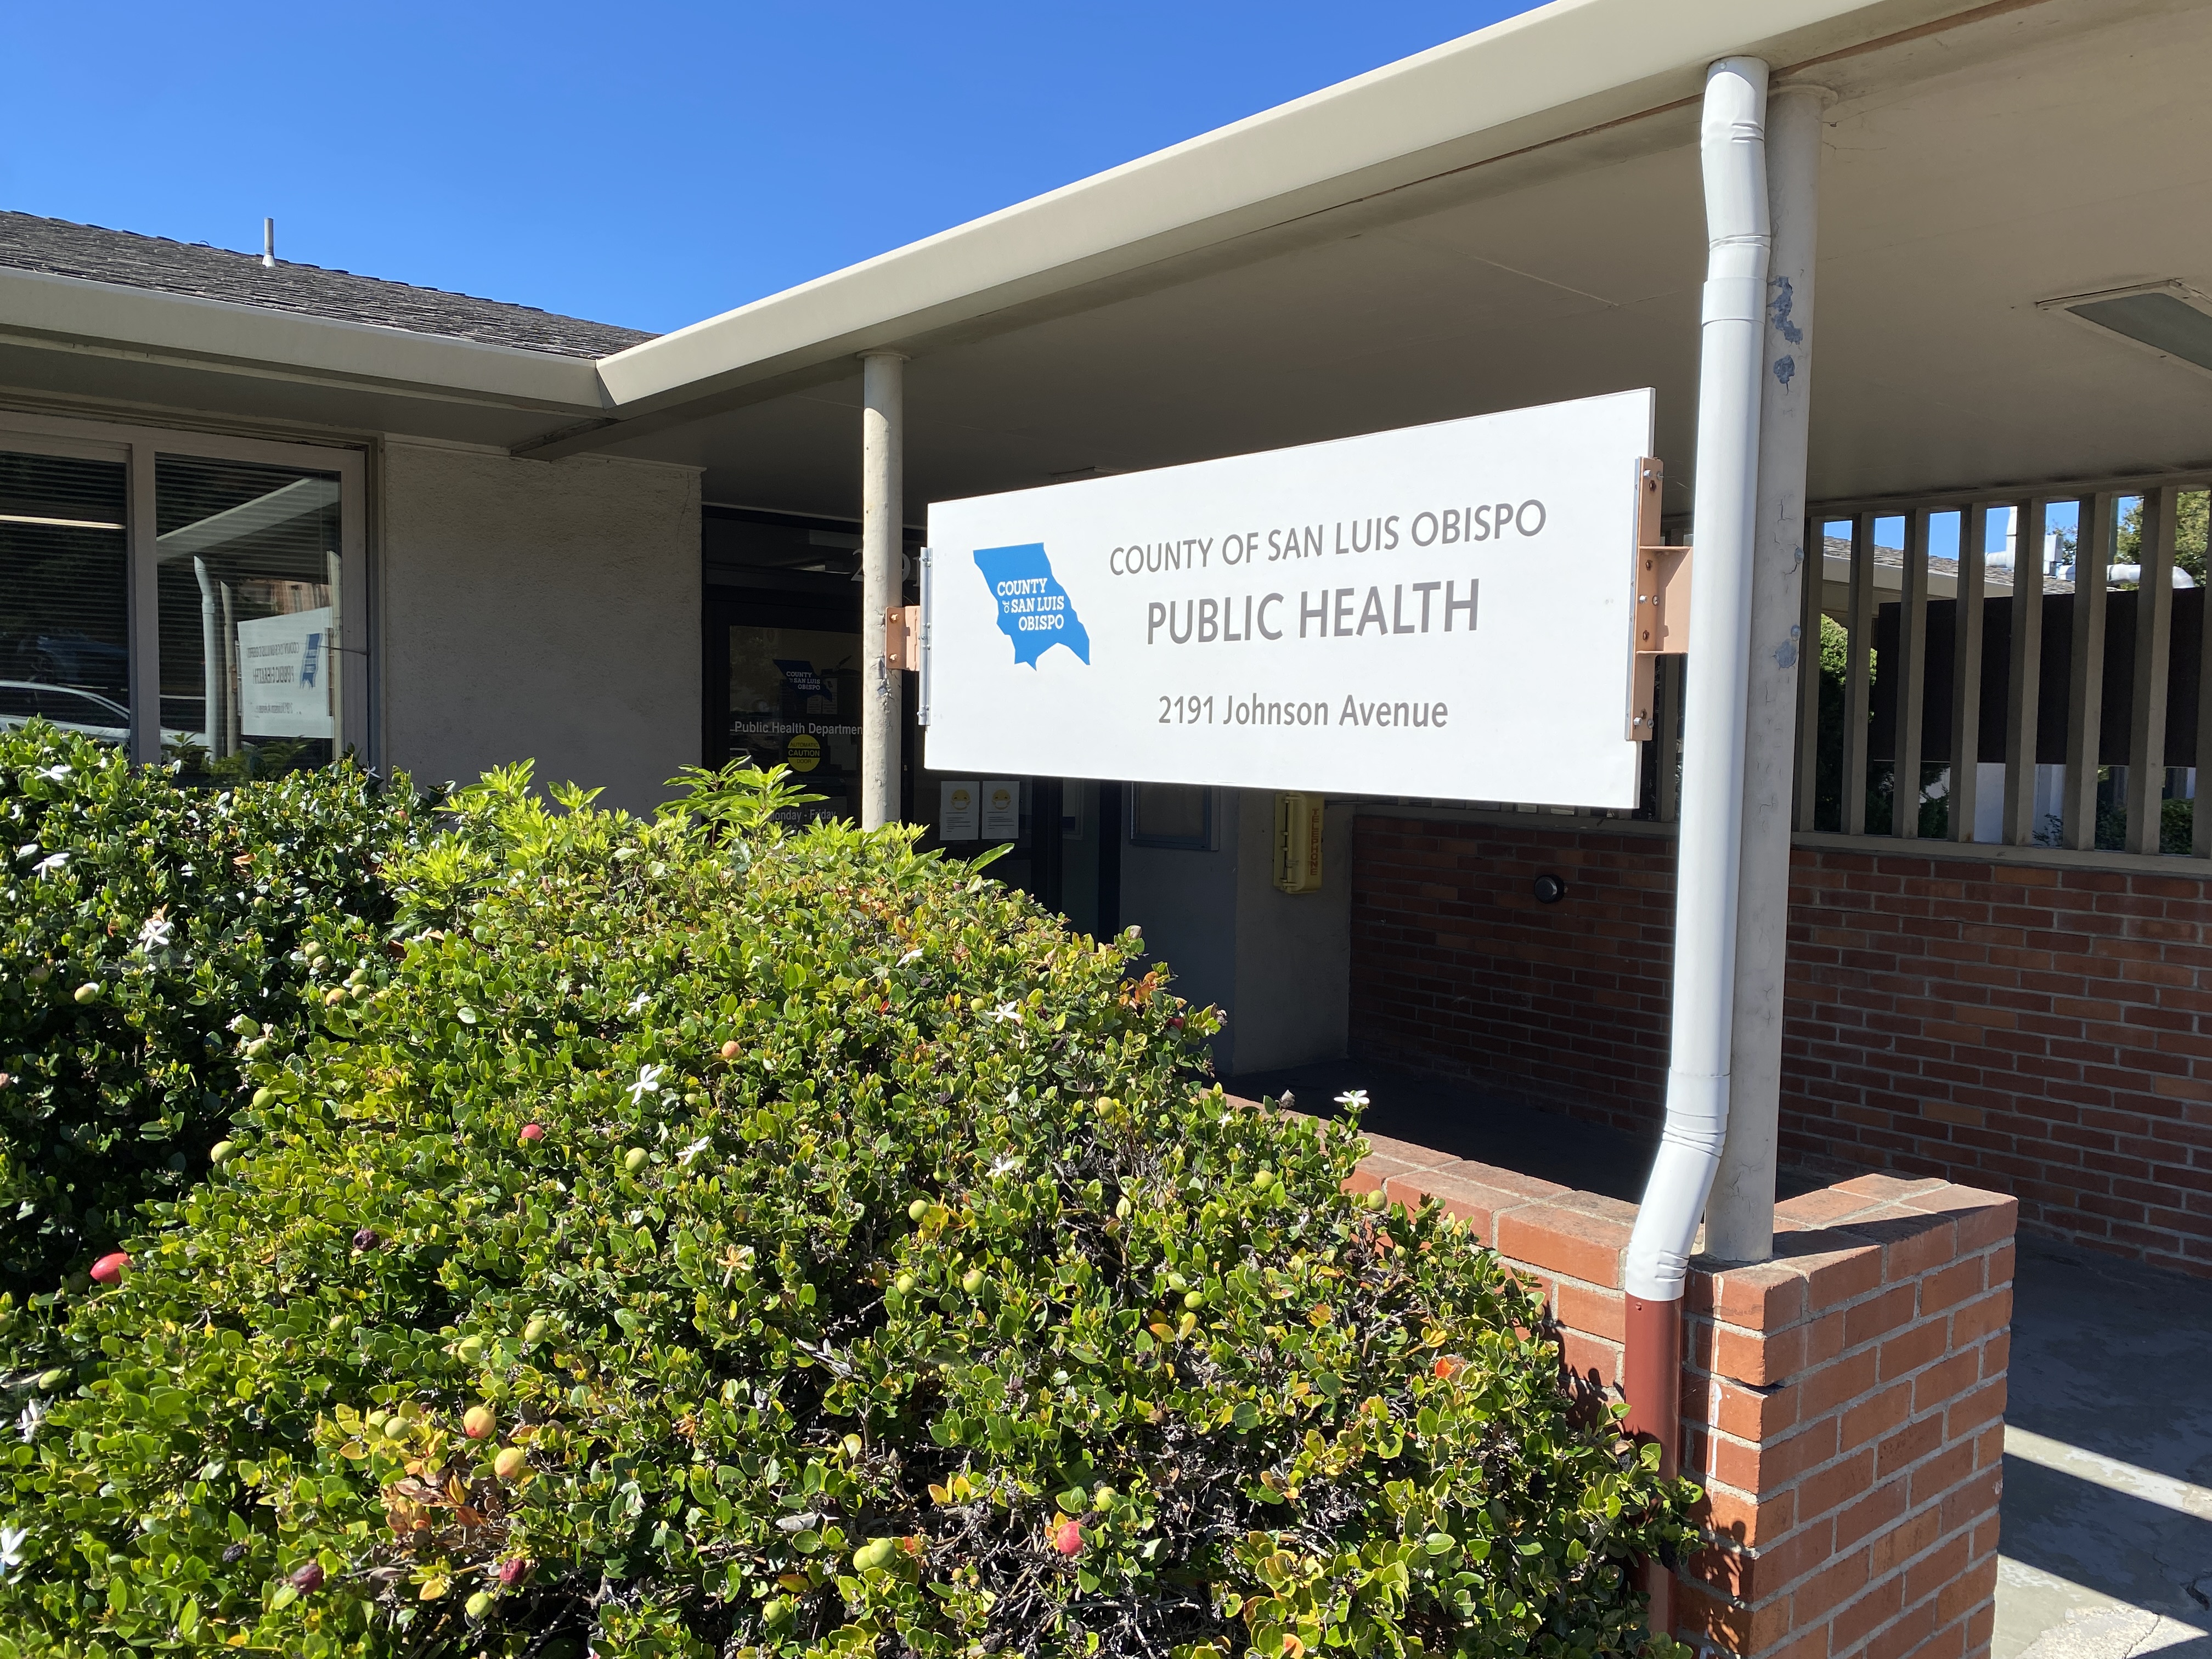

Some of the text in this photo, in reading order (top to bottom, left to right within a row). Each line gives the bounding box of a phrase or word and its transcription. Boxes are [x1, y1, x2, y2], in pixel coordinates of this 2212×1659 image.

[1110, 499, 1547, 576] COUNTY OF SAN LUIS OBISPO
[997, 577, 1048, 596] COUNTY
[1011, 597, 1035, 613] SAN
[1036, 595, 1065, 612] LUIS
[1147, 578, 1479, 645] PUBLIC HEALTH
[1018, 613, 1064, 631] OBISPO
[1158, 692, 1448, 728] 2191 Johnson Avenue
[735, 721, 863, 737] Public Health Departmen
[1310, 808, 1319, 876] TELEPHONE
